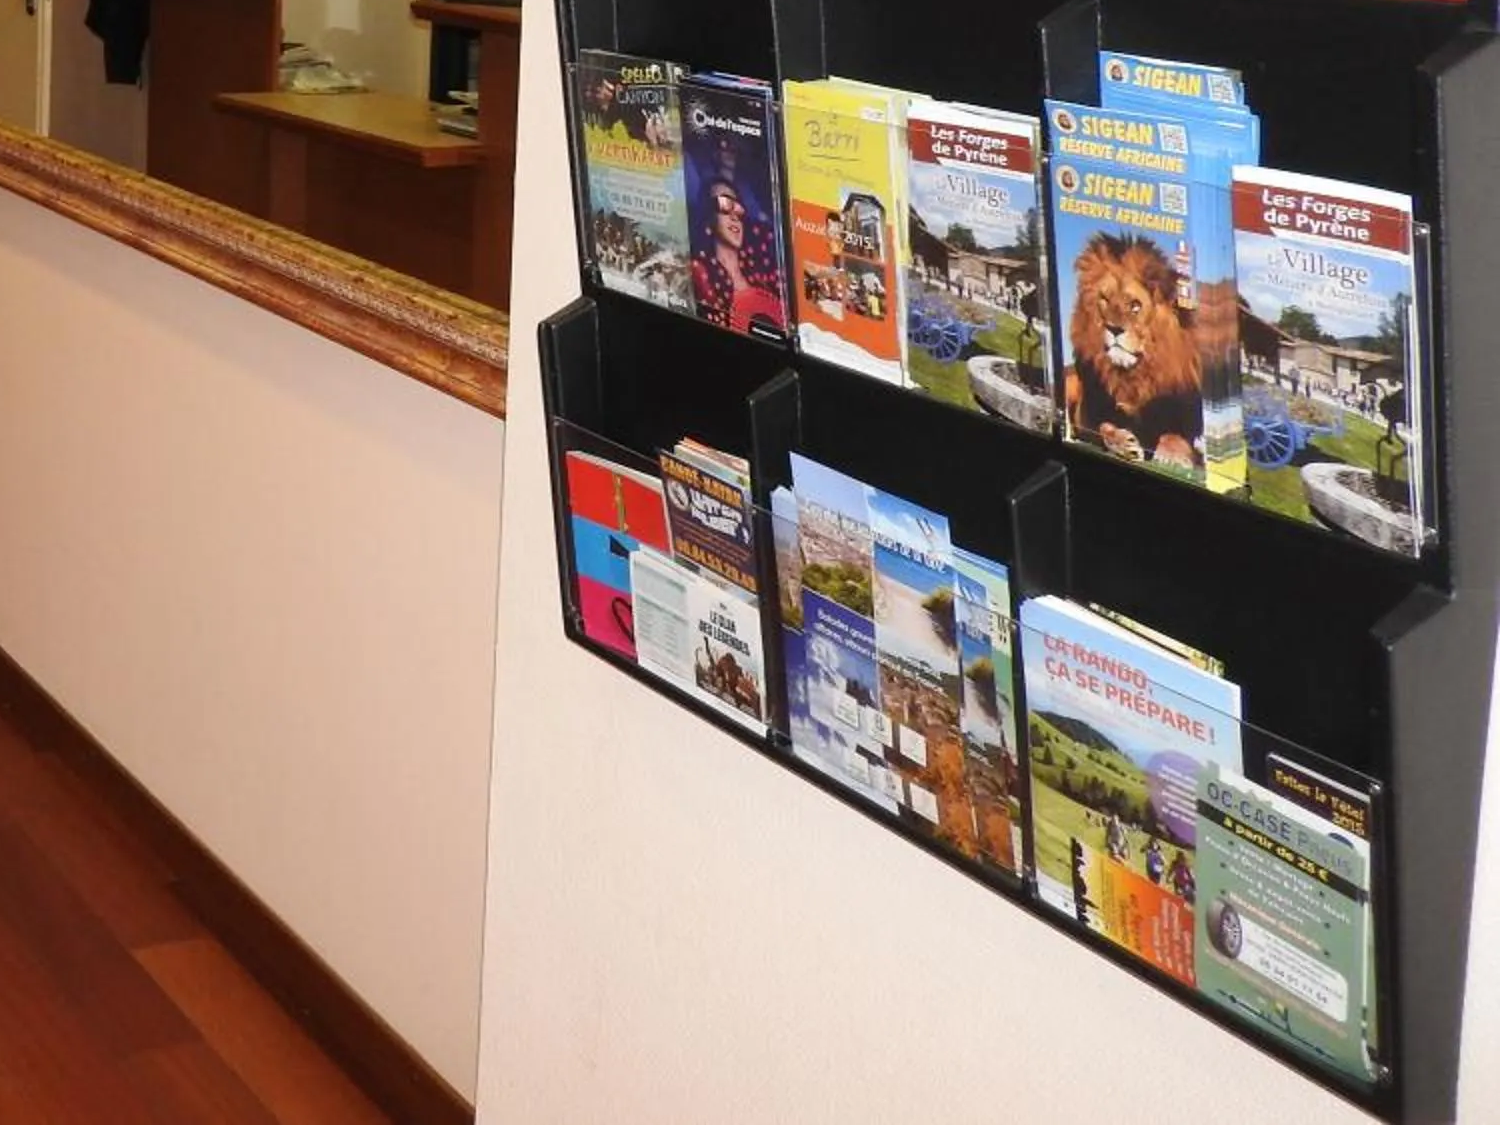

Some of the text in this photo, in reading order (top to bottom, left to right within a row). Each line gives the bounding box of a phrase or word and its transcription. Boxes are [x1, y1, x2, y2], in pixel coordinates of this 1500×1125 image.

[616, 87, 665, 104] CANYON
[1133, 65, 1202, 97] SIGEAN
[931, 125, 1009, 150] Les Forges
[1081, 115, 1154, 146] SIGEAN
[931, 140, 1008, 166] de Pyrène
[1115, 147, 1186, 174] AFRICAINE
[947, 174, 1009, 207] Village
[1083, 173, 1155, 206] SIGEAN
[1262, 188, 1372, 222] Les Forges
[1115, 207, 1186, 235] AFRICAINE
[1263, 208, 1371, 241] de Pyrène
[1283, 247, 1369, 289] Village
[1045, 656, 1071, 682] ÇA
[1075, 669, 1100, 694] SE
[1104, 681, 1207, 742] PRÉPARE
[1235, 823, 1273, 850] partir
[1275, 845, 1295, 862] de
